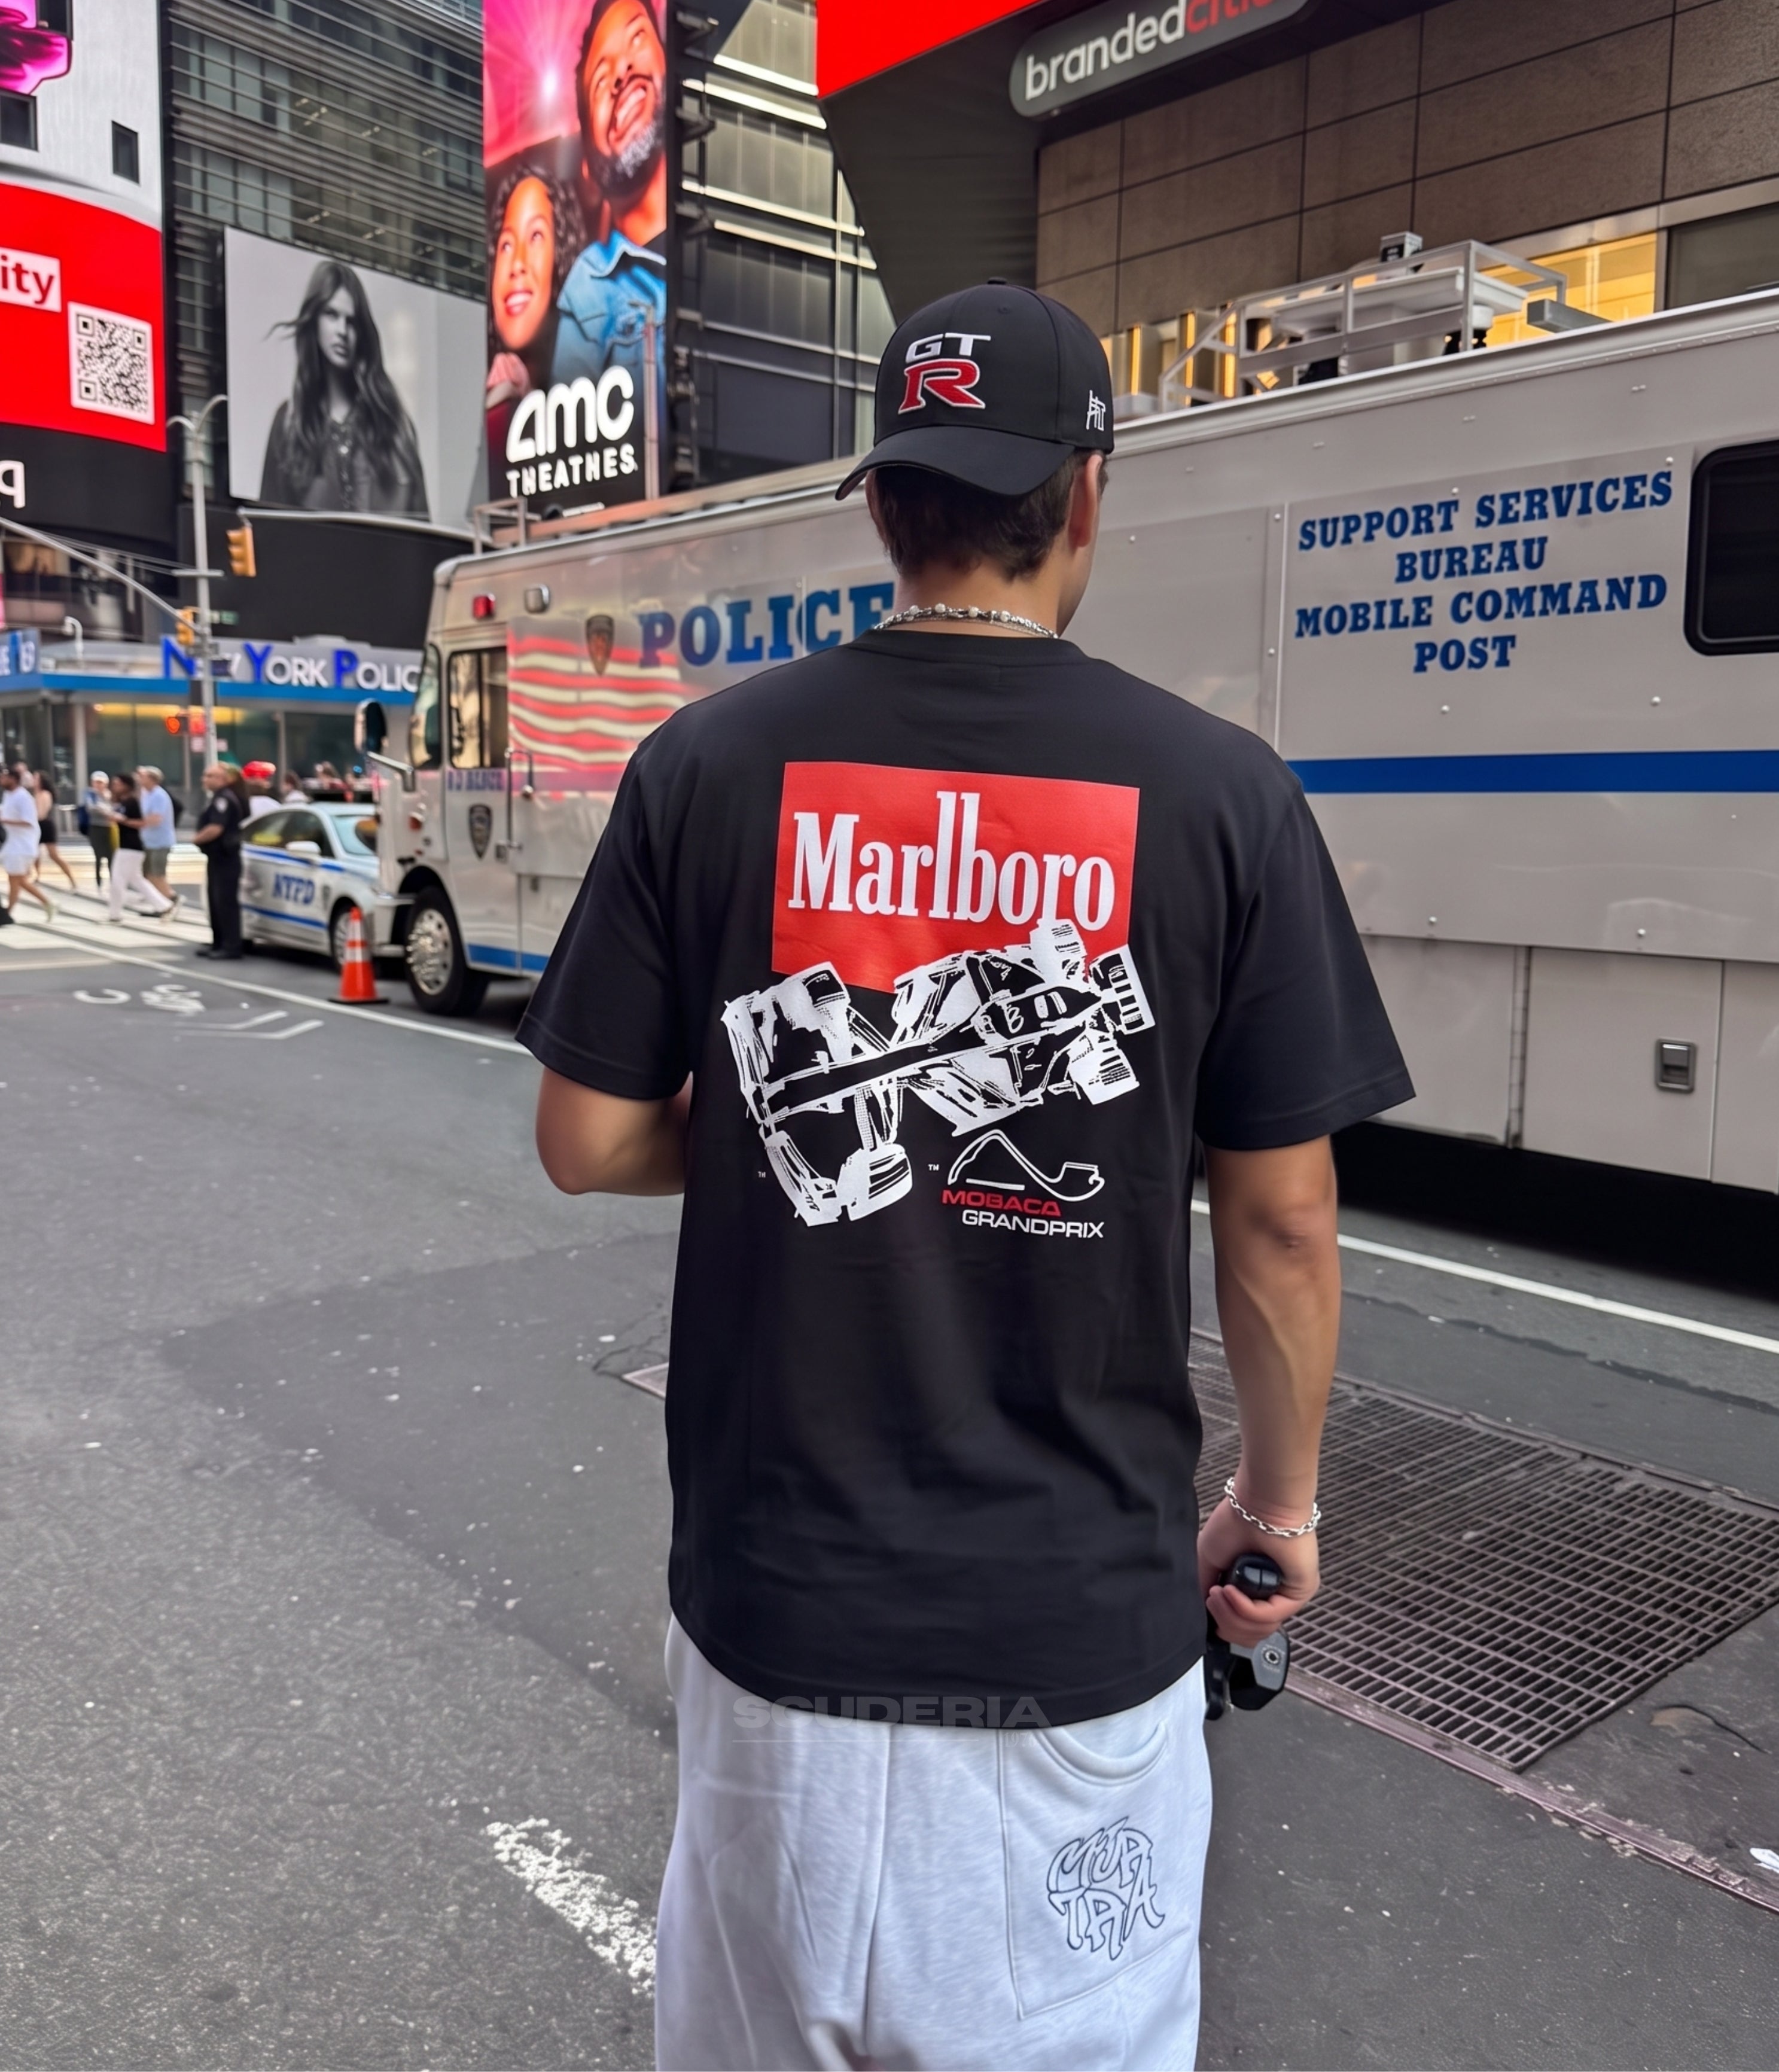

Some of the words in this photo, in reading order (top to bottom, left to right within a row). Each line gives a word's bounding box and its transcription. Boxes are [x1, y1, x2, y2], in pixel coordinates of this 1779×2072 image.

[905, 332, 991, 364] GT
[897, 358, 986, 415] R
[1299, 499, 1459, 551] SUPPORT
[1475, 471, 1673, 528] SERVICES
[1394, 536, 1548, 584] BUREAU
[638, 582, 894, 668] POLICE
[1294, 595, 1433, 638] MOBILE
[1450, 574, 1667, 625] COMMAND
[243, 643, 329, 688] YORK
[1413, 635, 1517, 673] POST
[788, 791, 1115, 931] Marlboro
[962, 1209, 1105, 1238] GRANDPRIX
